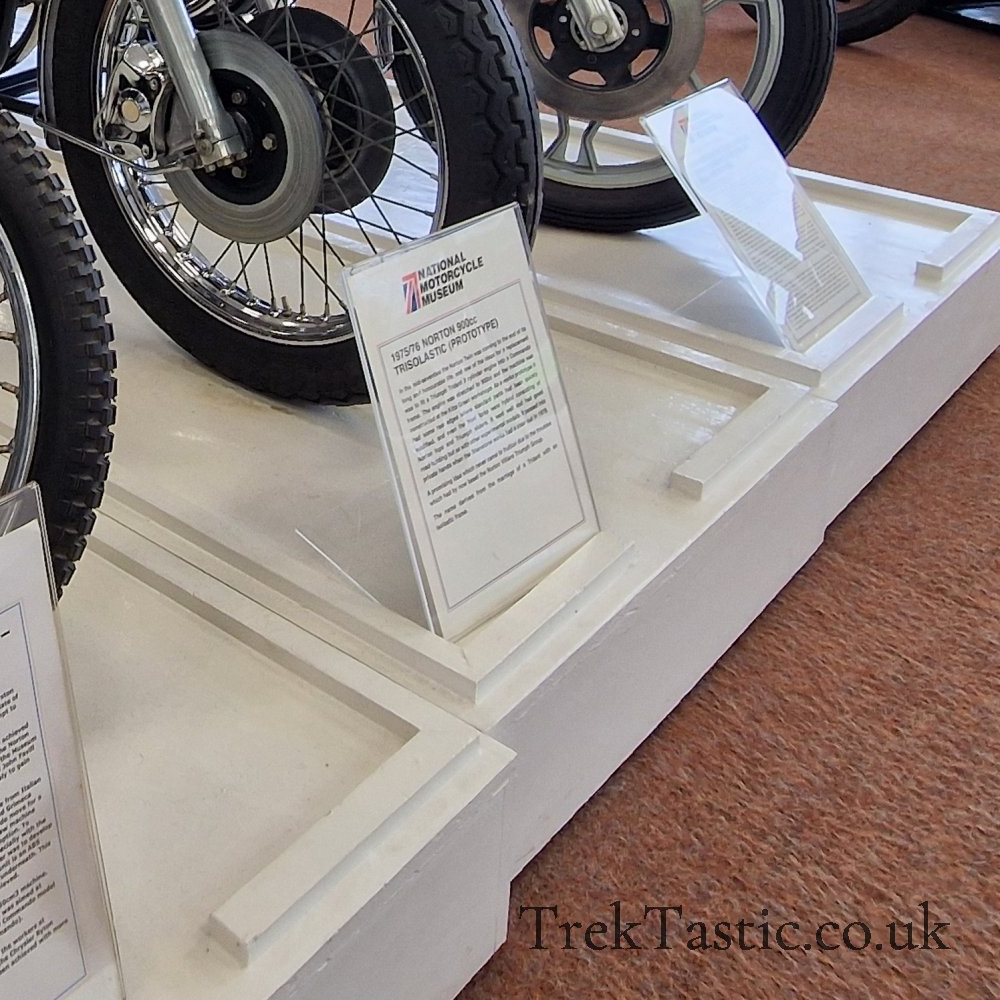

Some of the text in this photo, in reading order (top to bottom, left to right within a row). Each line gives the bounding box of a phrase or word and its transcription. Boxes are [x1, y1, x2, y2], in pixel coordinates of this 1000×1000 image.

[418, 251, 467, 280] NATIONAL
[420, 256, 484, 293] MOTORCYCLE
[422, 279, 464, 306] MUSEUM
[391, 316, 478, 362] 1975/76 NORTON 900cc
[394, 343, 448, 375] TRISOLASTIC
[448, 317, 499, 351] (PROTOTYPE)
[1, 721, 28, 744] achieved
[7, 729, 28, 748] Norton
[0, 751, 10, 763] the
[11, 734, 36, 755] Museum
